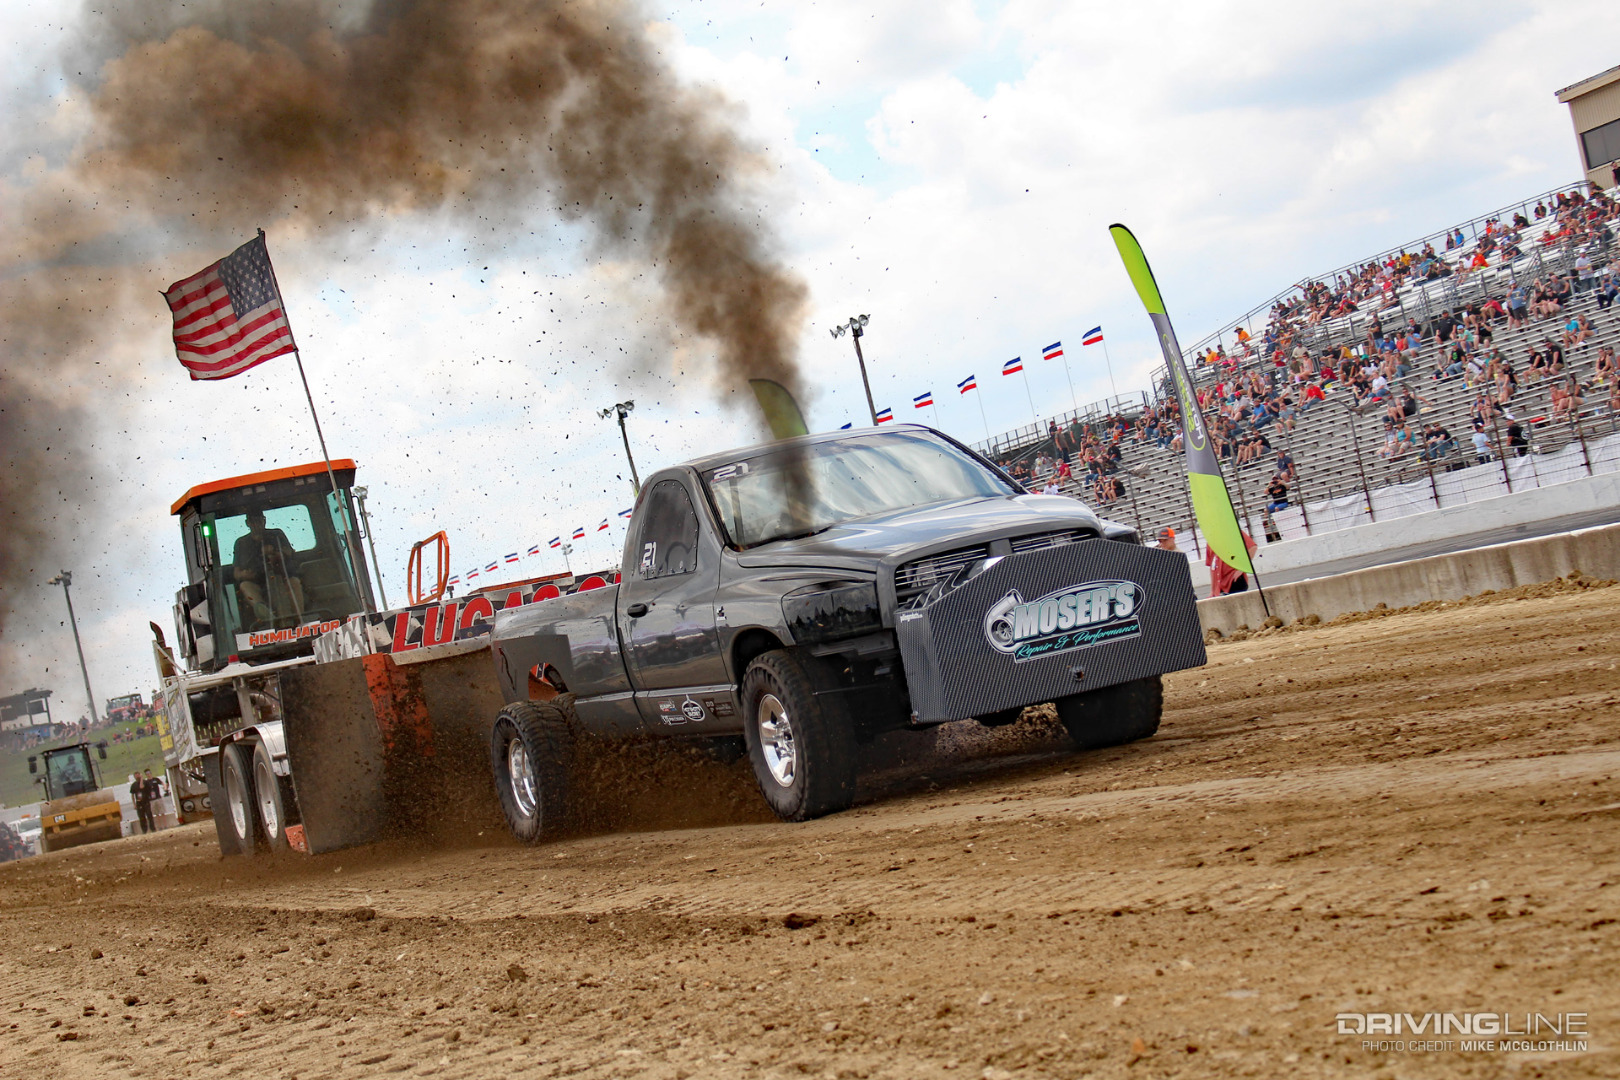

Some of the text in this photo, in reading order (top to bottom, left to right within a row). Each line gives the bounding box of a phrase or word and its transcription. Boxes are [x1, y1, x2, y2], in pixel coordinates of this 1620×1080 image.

[713, 462, 749, 480] 21
[642, 541, 657, 565] 21
[1013, 582, 1135, 641] MOSER'S
[249, 619, 340, 646] HUMILIATOR
[1015, 624, 1138, 660] Repair & Performance
